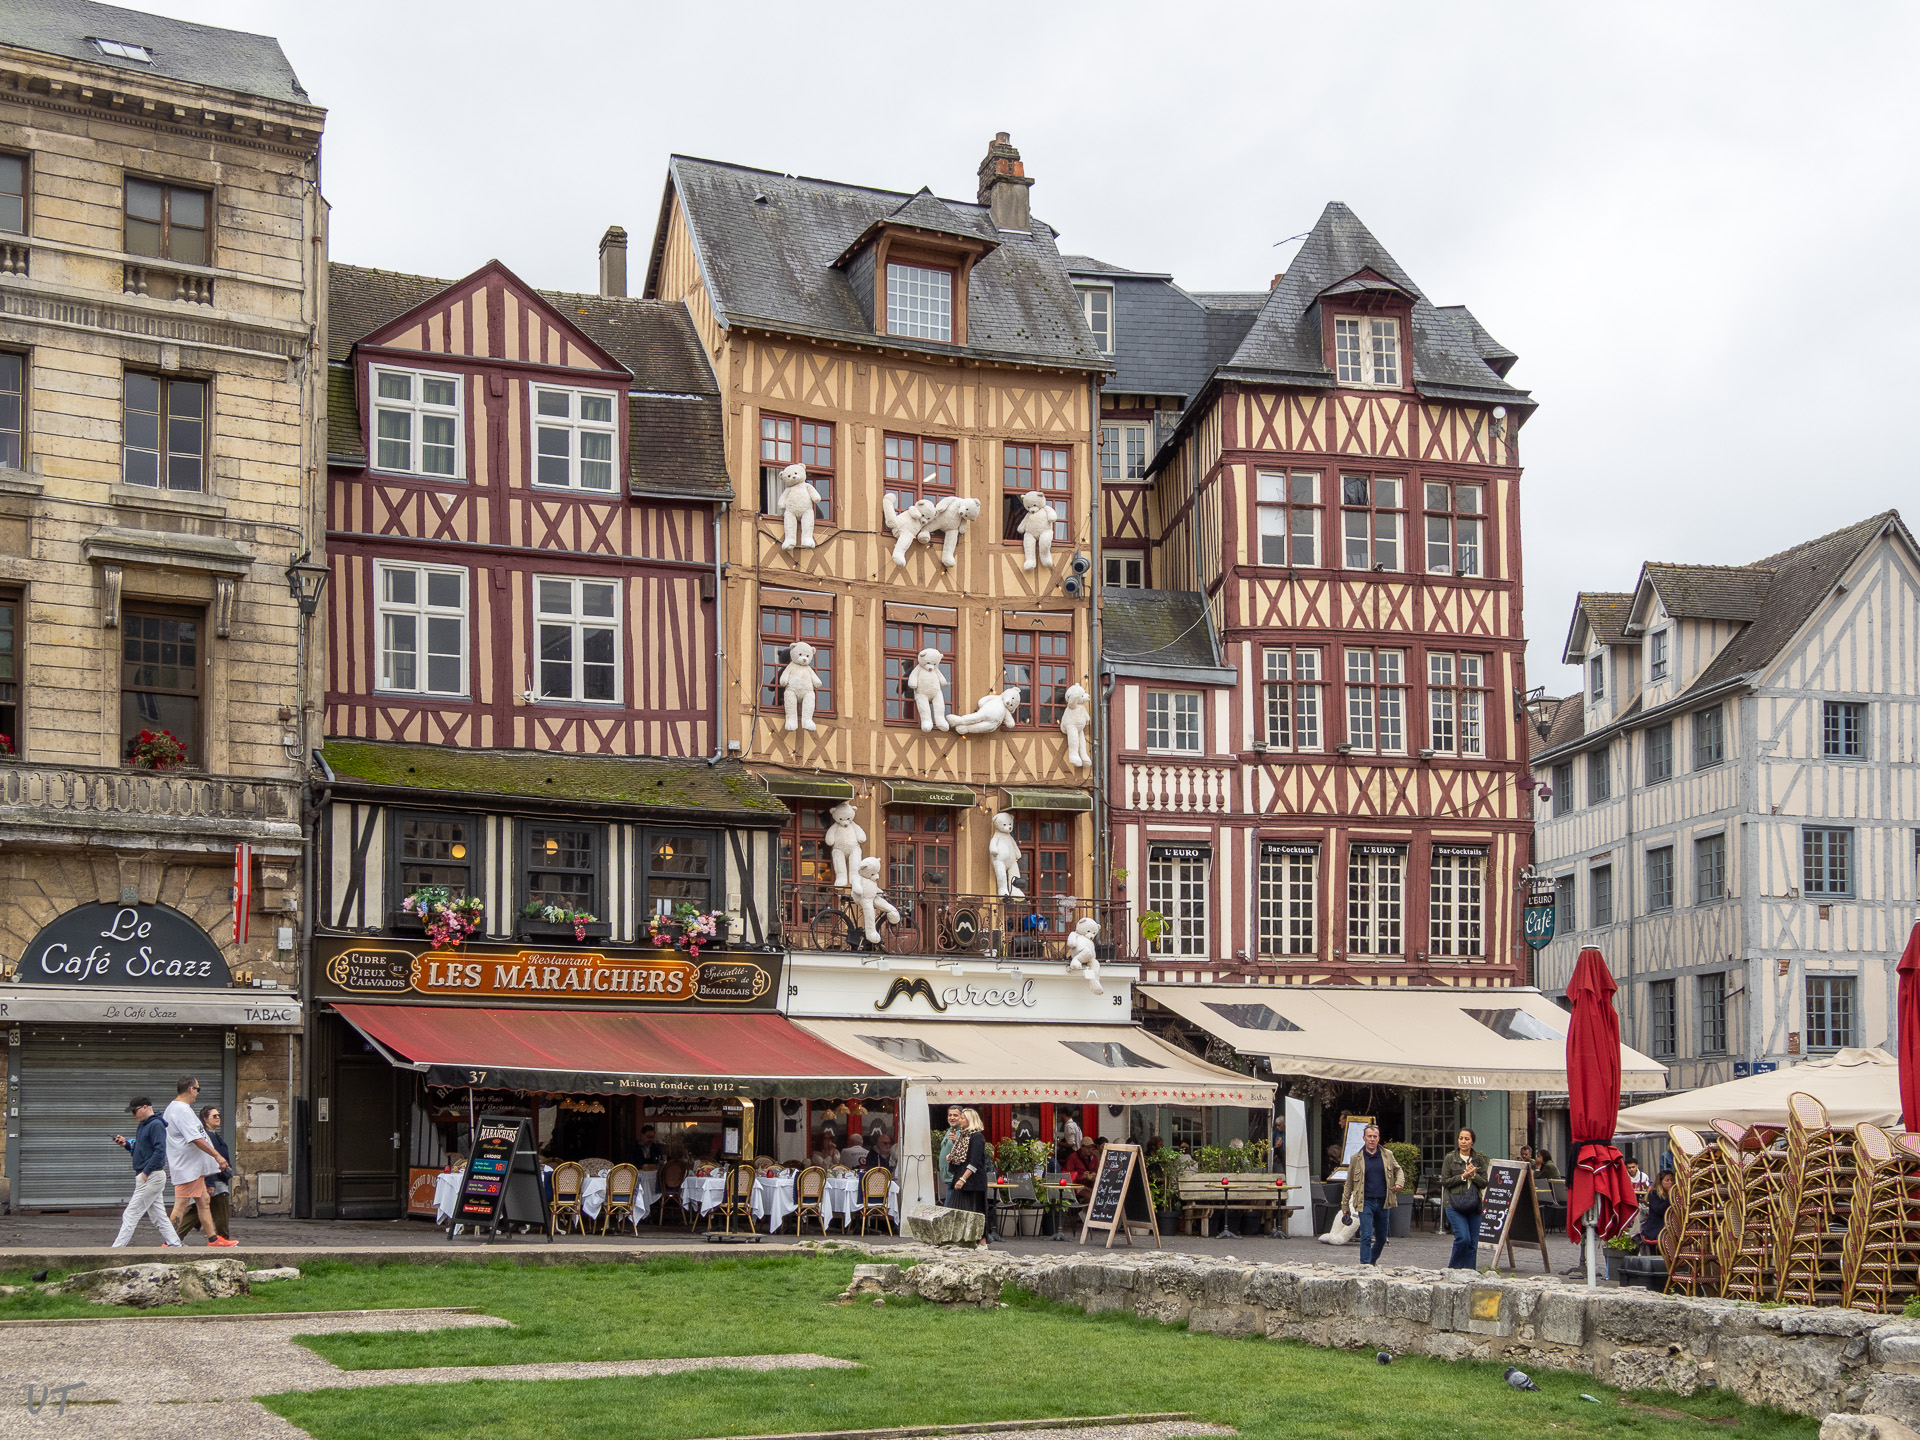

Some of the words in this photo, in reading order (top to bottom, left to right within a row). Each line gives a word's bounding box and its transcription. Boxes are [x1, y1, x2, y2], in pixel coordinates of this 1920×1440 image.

[1165, 848, 1199, 857] L'EURO
[1268, 845, 1314, 854] Bar-Cocktails
[1363, 846, 1396, 854] L'EURO
[1438, 847, 1482, 856] Bar-Cocktails
[1528, 895, 1553, 905] L'EURO
[100, 908, 152, 942] Le
[1525, 908, 1552, 940] Café
[41, 943, 111, 982] Café
[125, 946, 212, 977] Scazz
[351, 953, 387, 965] CIDRE
[527, 953, 594, 966] Restaurant
[350, 966, 386, 977] VIEUX
[427, 962, 482, 988] LES
[493, 965, 684, 993] MARAICHERS
[349, 976, 406, 987] CALVADOS
[700, 985, 750, 995] BEAUJOLAIS
[874, 976, 1037, 1013] Marcel
[1112, 995, 1122, 1006] 39
[103, 1006, 120, 1018] Le
[124, 1006, 146, 1019] Café
[149, 1007, 177, 1018] Scazz
[244, 1008, 292, 1021] TABAC
[10, 1032, 19, 1044] 35
[226, 1034, 235, 1046] 35
[468, 1070, 487, 1084] 37
[619, 1079, 657, 1089] Maison
[660, 1081, 694, 1091] fondée
[713, 1082, 735, 1091] 1912
[852, 1082, 868, 1095] 37
[1251, 1093, 1267, 1101] Bistro
